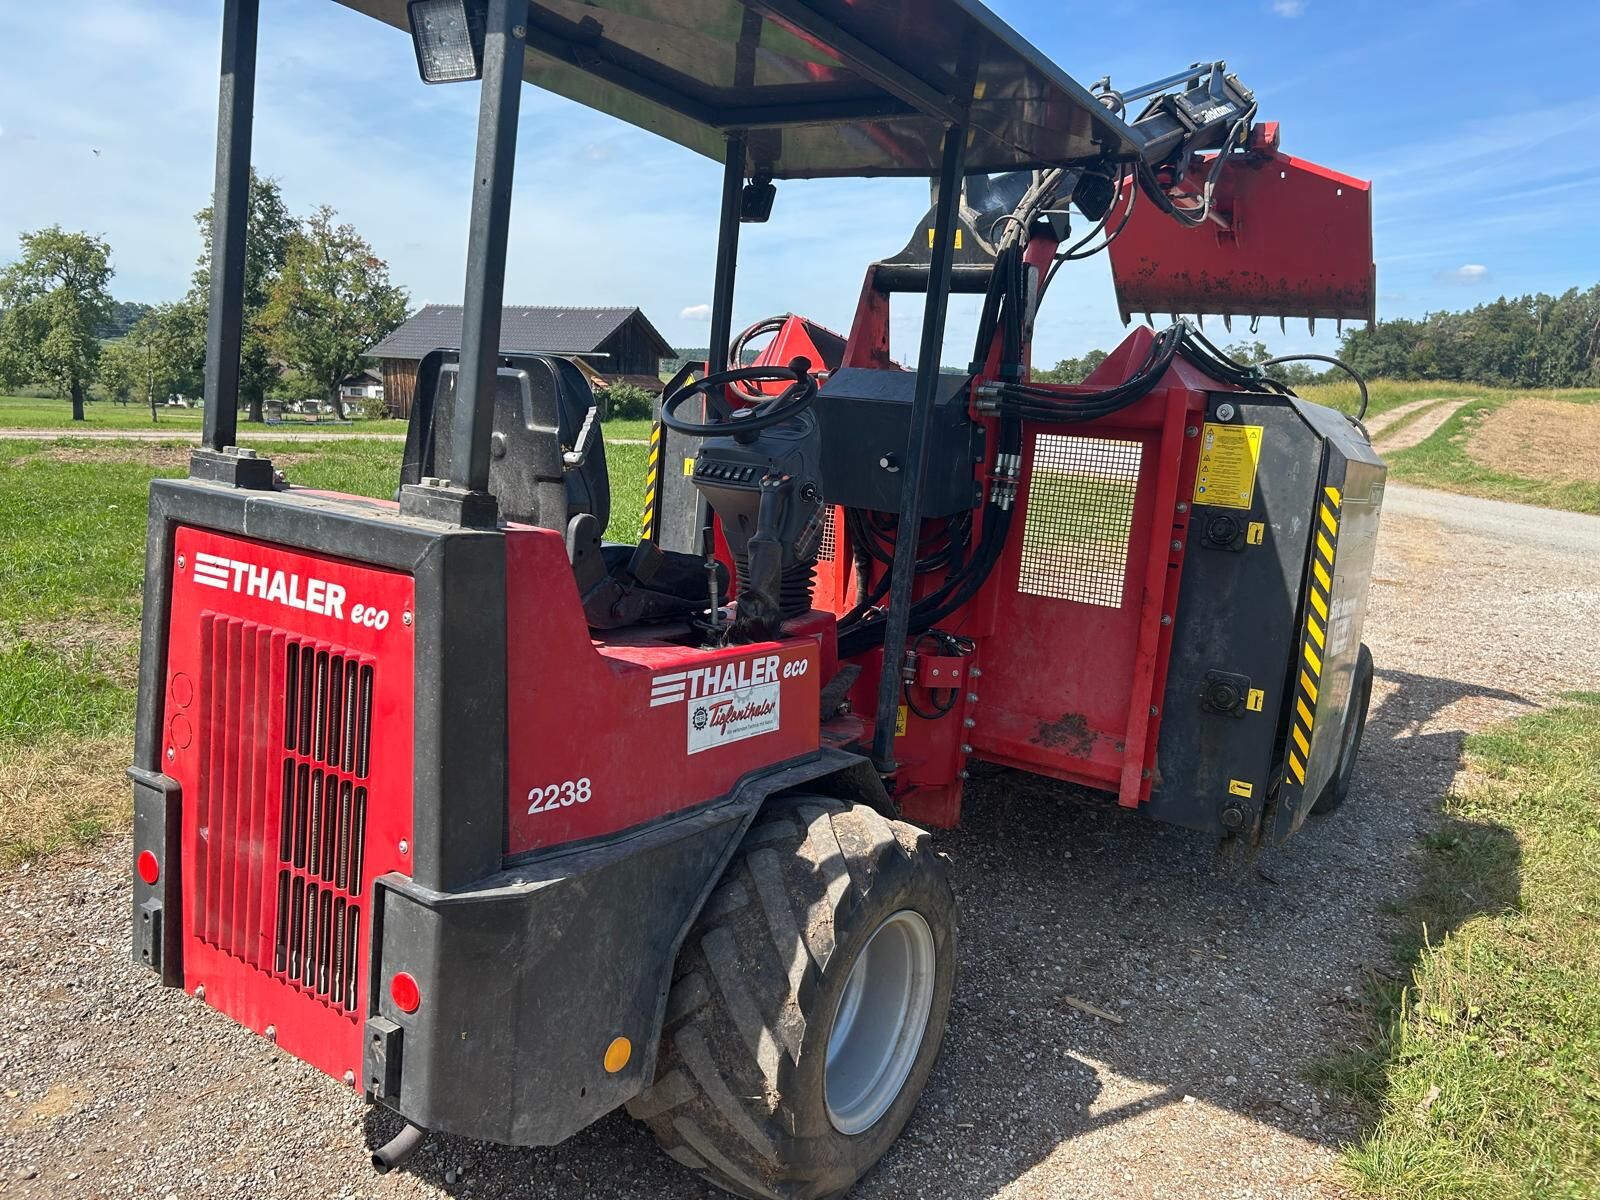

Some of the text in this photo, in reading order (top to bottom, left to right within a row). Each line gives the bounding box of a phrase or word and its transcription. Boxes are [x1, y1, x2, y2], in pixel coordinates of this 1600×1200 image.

[230, 559, 390, 631] THALER eco
[686, 655, 809, 699] THALER eco
[527, 777, 592, 815] 2238
